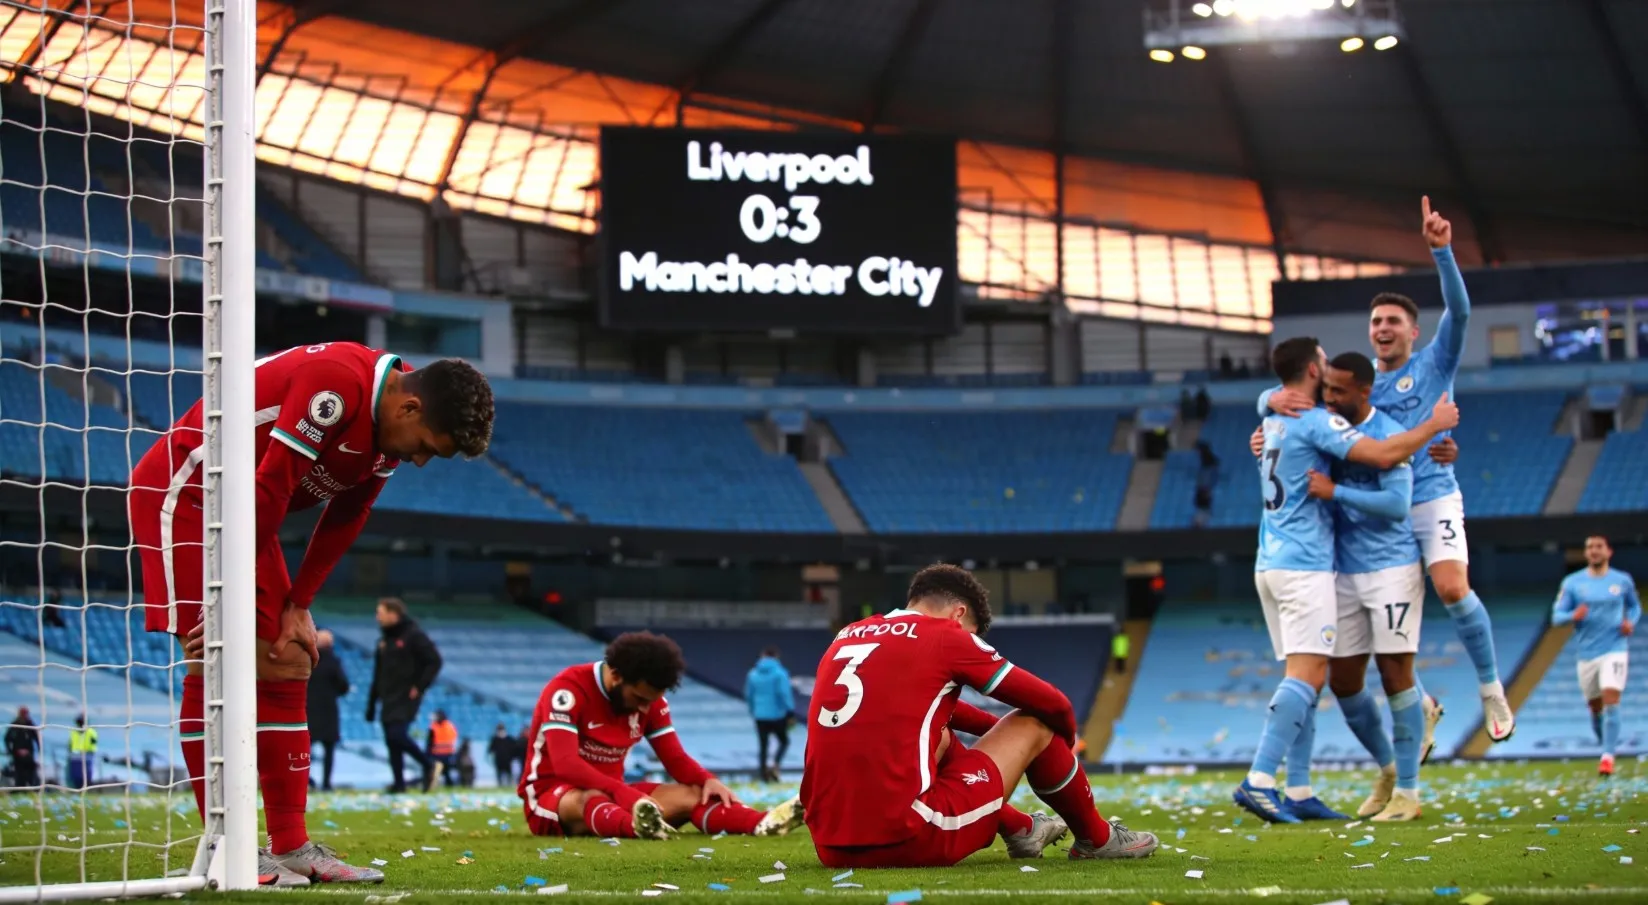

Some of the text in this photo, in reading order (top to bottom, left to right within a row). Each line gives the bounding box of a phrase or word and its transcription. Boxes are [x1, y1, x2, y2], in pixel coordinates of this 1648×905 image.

[687, 140, 873, 191] Liverpool
[739, 194, 821, 244] 0:3
[619, 250, 943, 307] Manchester City
[1438, 519, 1457, 540] 3
[1384, 602, 1411, 630] 17
[817, 642, 881, 728] 3
